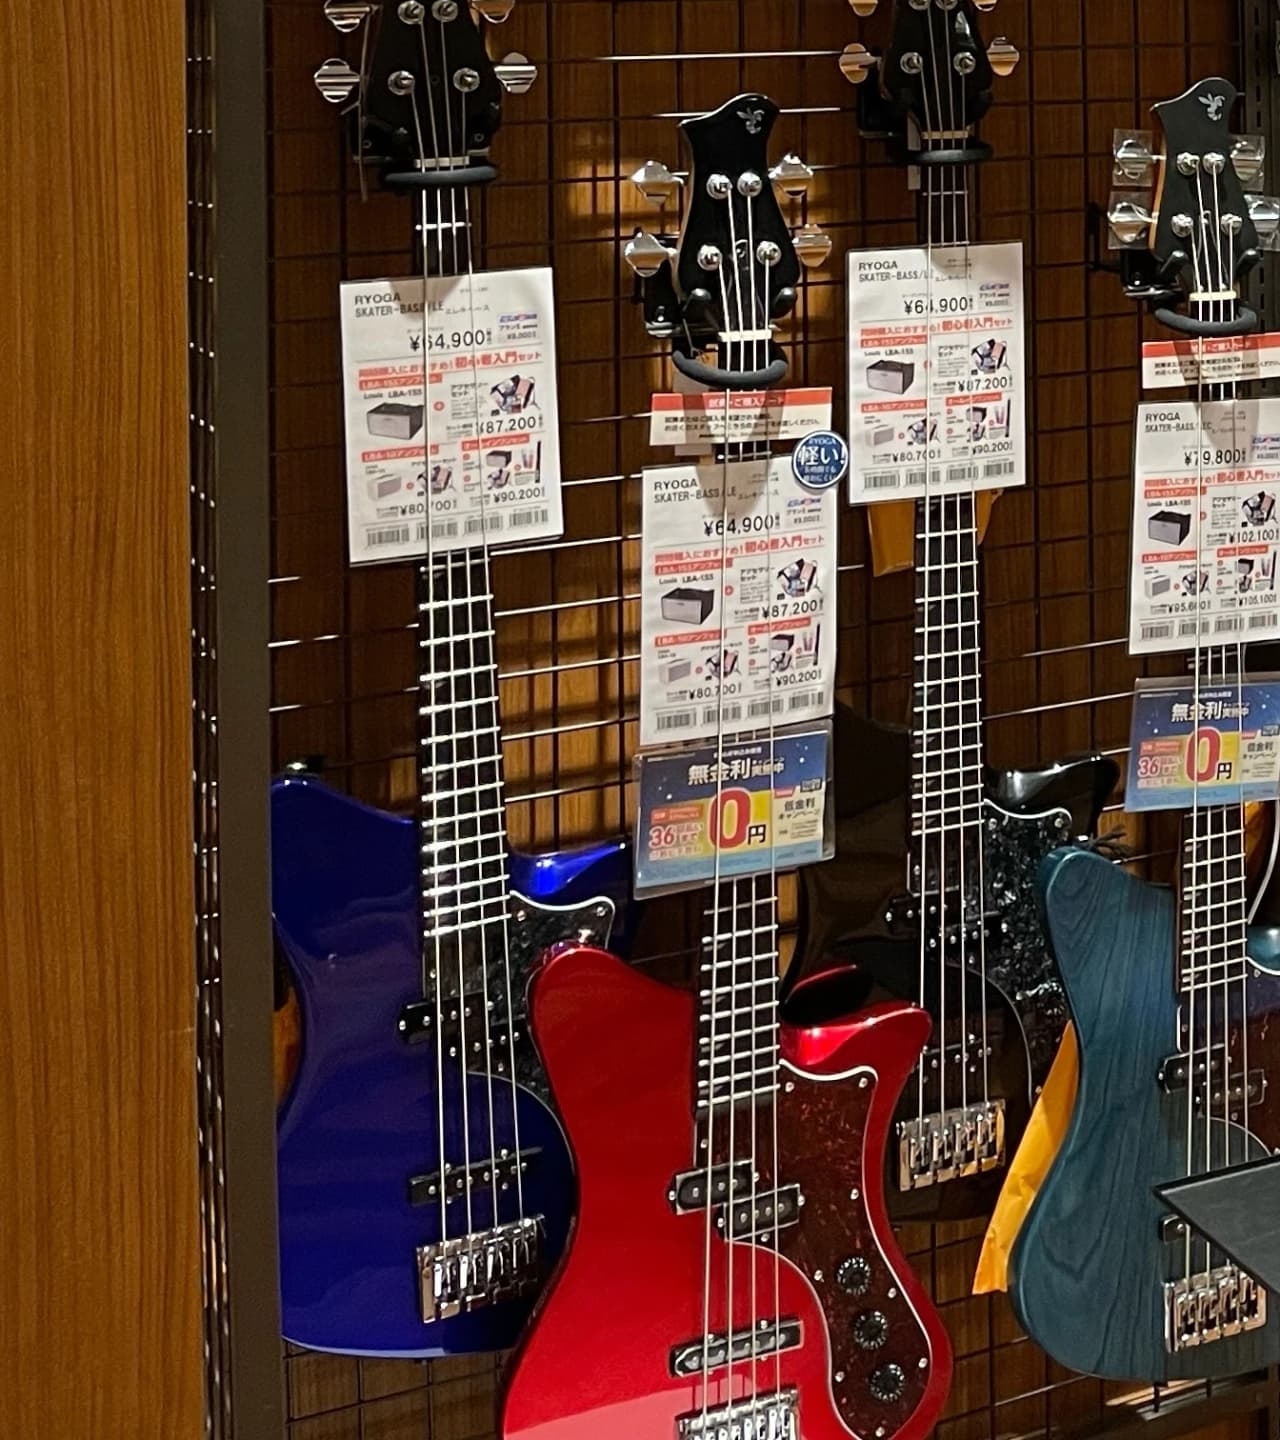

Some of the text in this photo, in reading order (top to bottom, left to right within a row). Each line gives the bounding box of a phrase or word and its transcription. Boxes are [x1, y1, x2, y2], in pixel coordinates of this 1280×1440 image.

[859, 261, 898, 271] RYOGA
[354, 292, 401, 304] RYOGA
[1145, 412, 1181, 423] RYOGA
[654, 478, 698, 491] RYOGA
